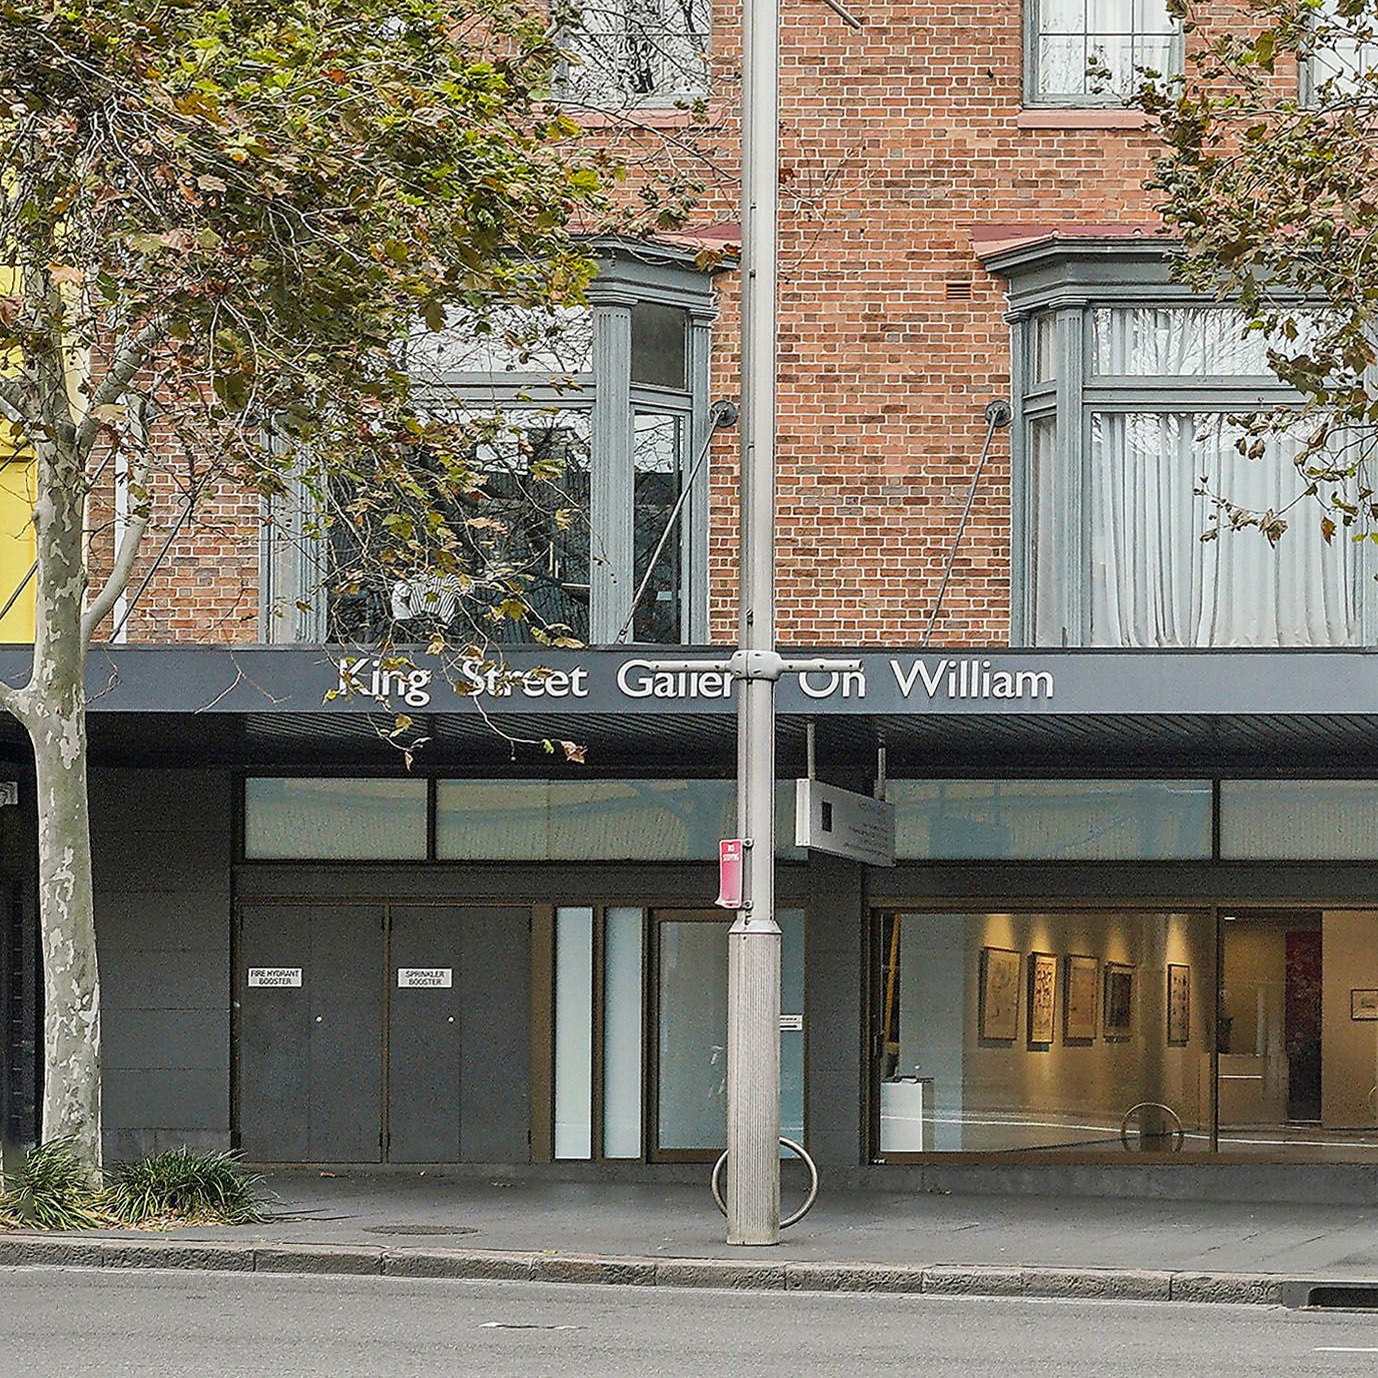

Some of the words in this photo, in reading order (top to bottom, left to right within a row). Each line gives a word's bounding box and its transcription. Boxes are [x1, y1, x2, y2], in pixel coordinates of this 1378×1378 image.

[338, 658, 432, 707] King
[462, 659, 589, 698] Street
[616, 659, 736, 698] Galler
[799, 659, 866, 698] On
[890, 659, 1053, 698] William
[250, 969, 265, 977] FIRE
[267, 969, 299, 977] HYDRANT
[405, 970, 445, 978] SPRINKLER
[259, 977, 292, 985] BOOSTER
[408, 978, 442, 986] BOOSTER
